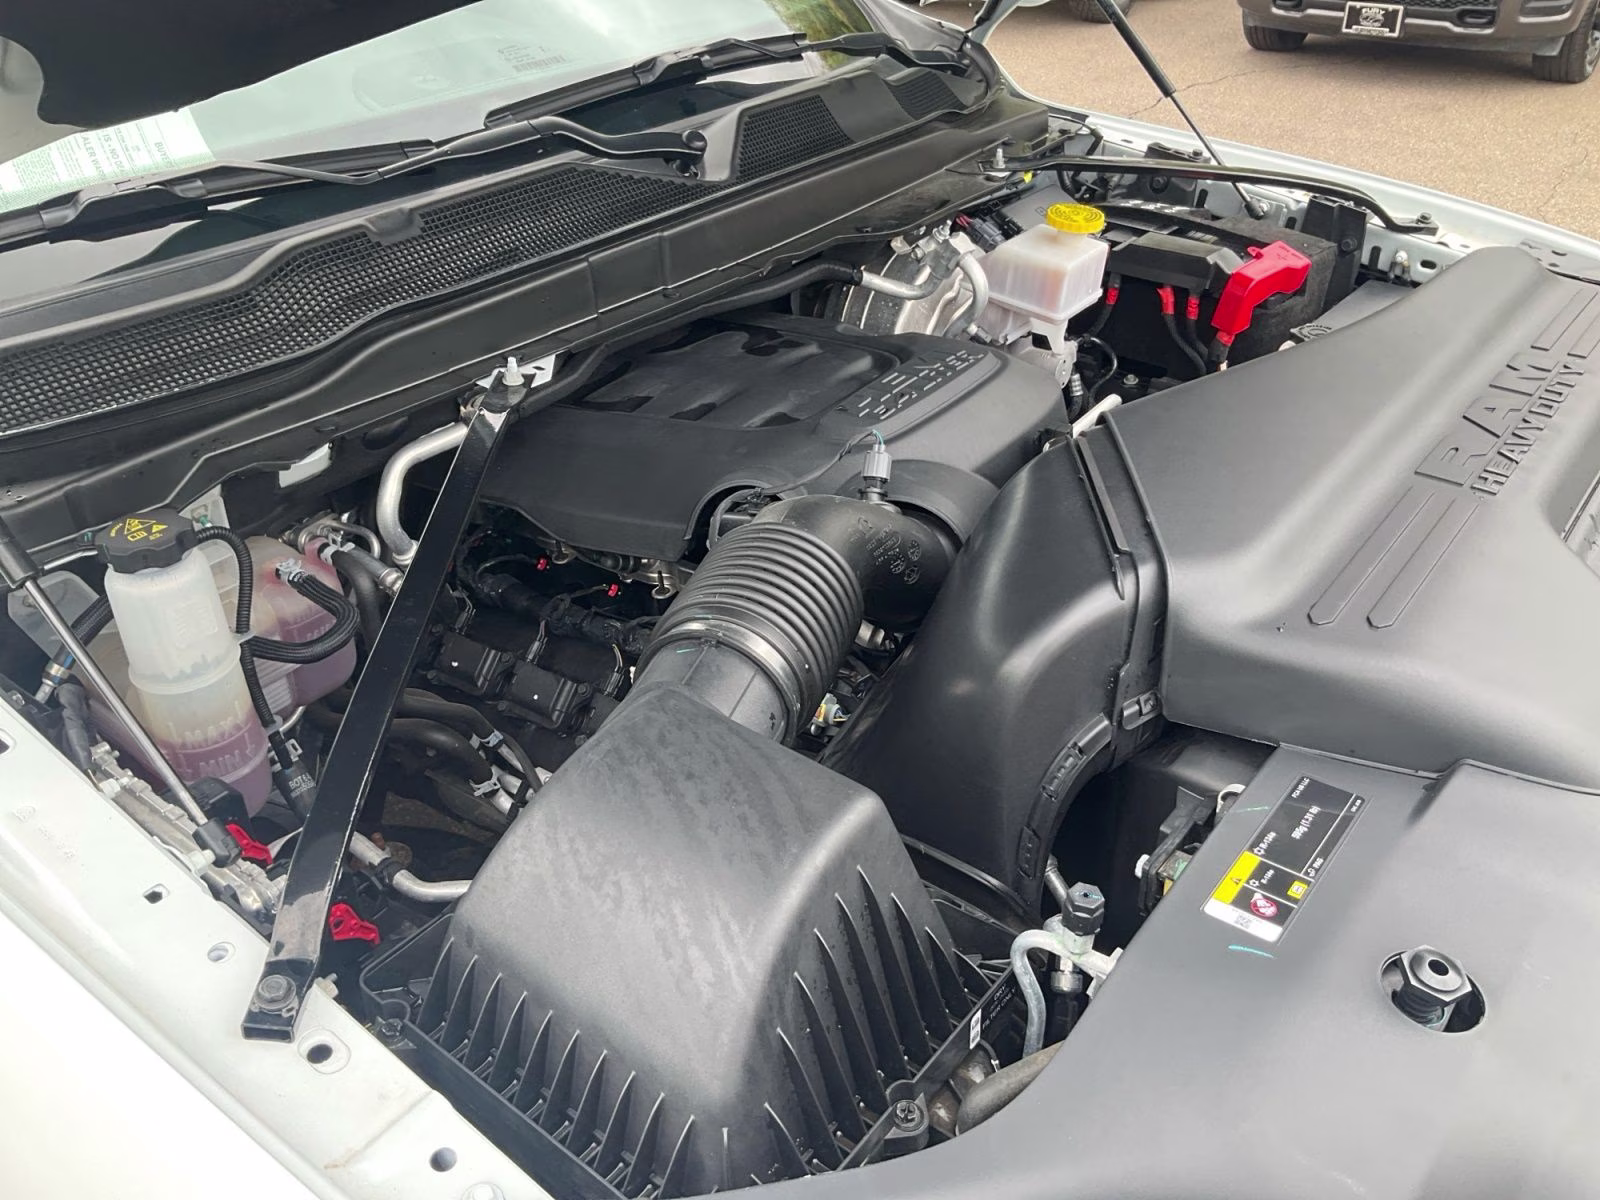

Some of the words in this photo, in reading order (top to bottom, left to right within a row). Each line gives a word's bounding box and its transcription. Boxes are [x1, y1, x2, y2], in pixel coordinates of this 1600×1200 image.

[1415, 352, 1560, 486] RAM
[1470, 417, 1546, 495] HEAVY
[1528, 363, 1585, 418] DUTY
